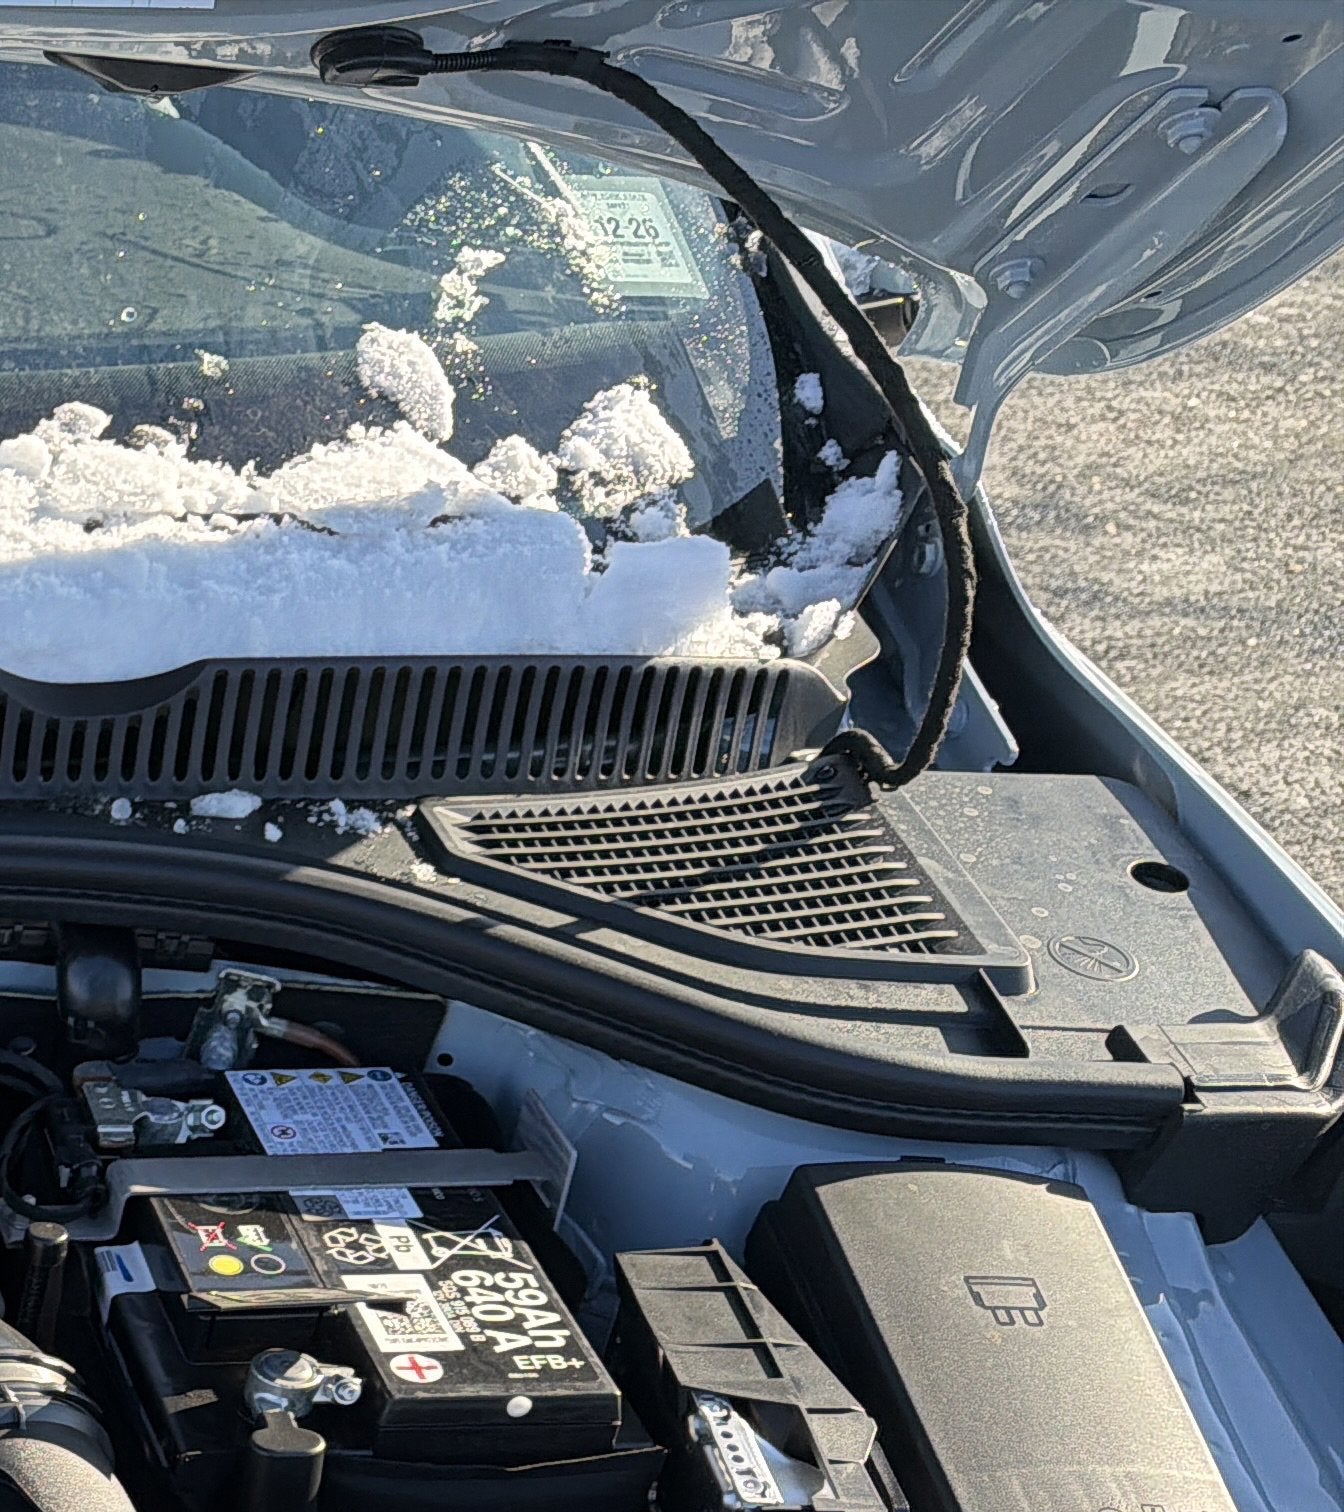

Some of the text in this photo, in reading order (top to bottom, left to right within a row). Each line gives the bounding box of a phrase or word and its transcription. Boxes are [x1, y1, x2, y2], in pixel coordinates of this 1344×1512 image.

[388, 1235, 413, 1253] Pb
[450, 1269, 516, 1322] 640
[483, 1328, 533, 1354] A
[494, 1271, 571, 1348] 59Ah
[512, 1354, 585, 1370] EFB+
